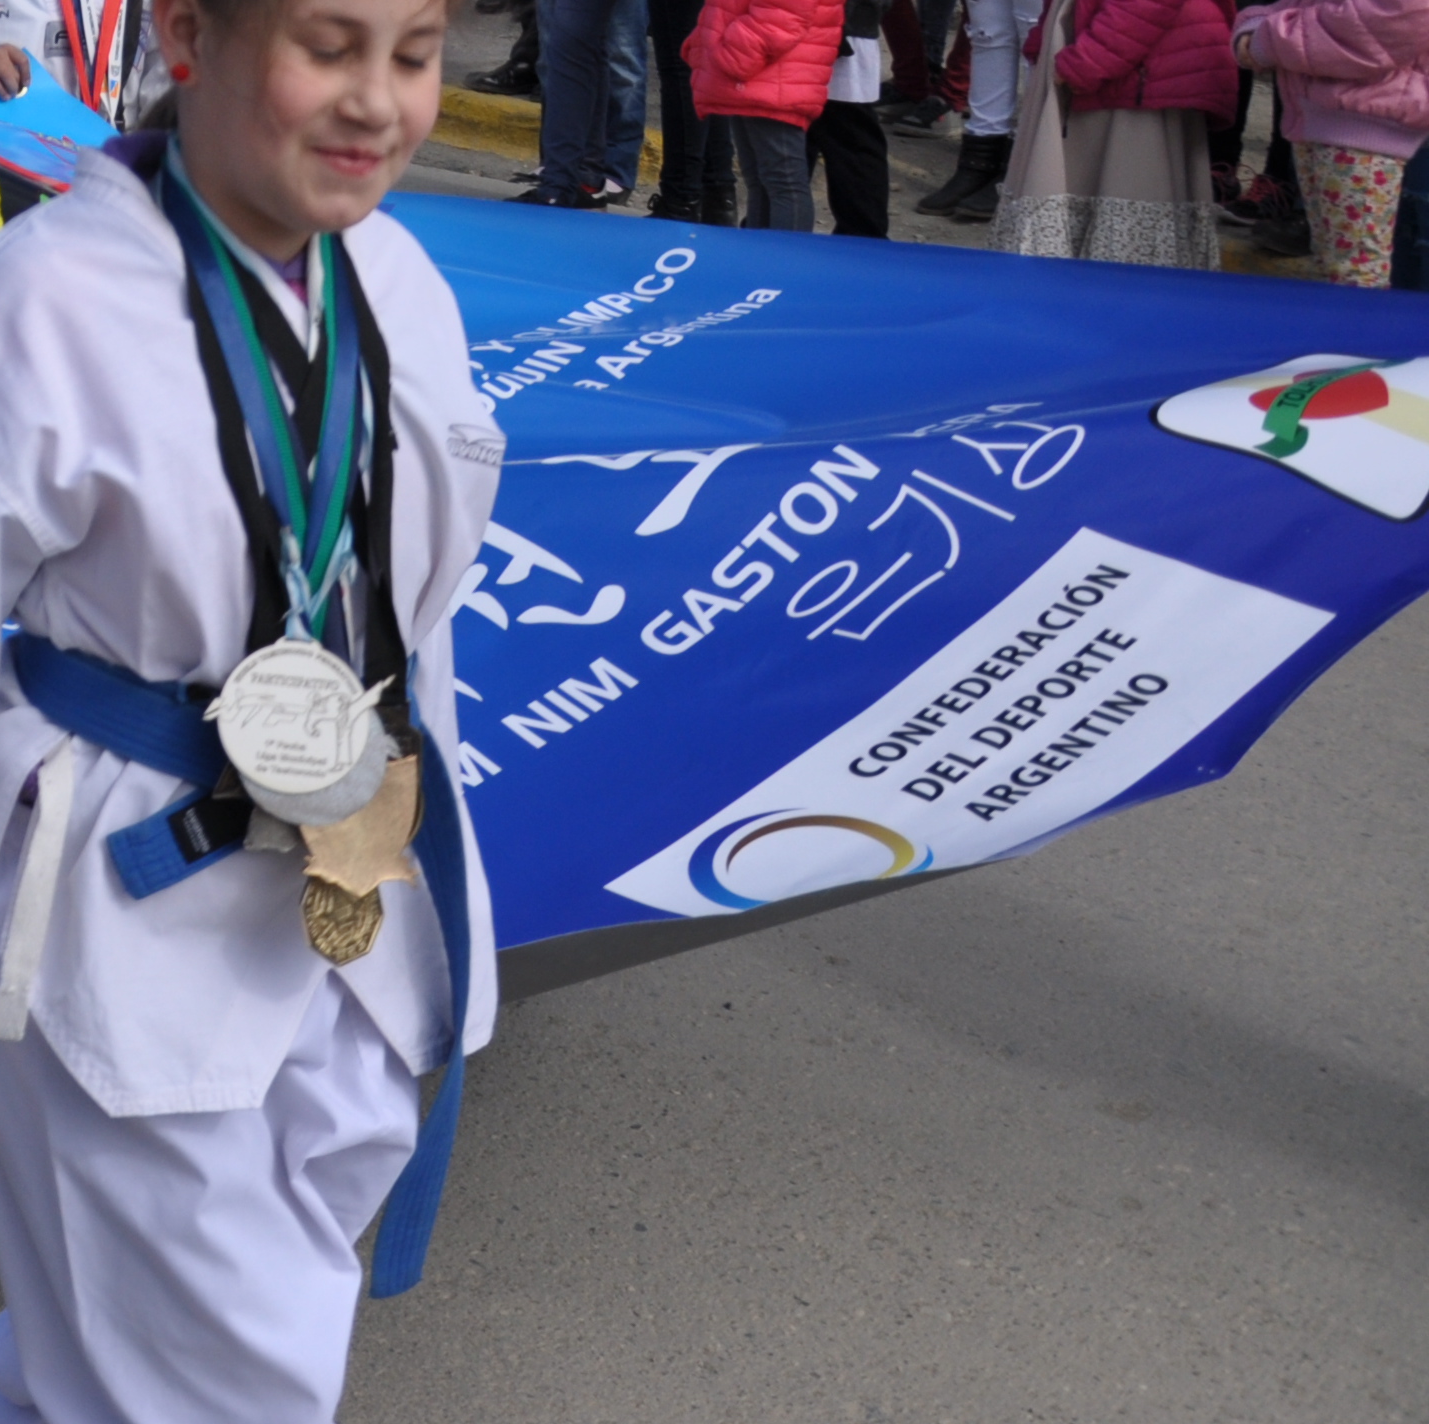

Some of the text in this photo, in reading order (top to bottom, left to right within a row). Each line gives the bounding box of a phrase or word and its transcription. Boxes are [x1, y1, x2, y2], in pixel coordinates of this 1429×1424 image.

[500, 657, 640, 750] NIM
[640, 444, 881, 656] GASTON
[848, 564, 1131, 778] CONFEDERACIÓN
[900, 628, 1138, 802] DEL DEPORTE
[964, 673, 1169, 822] ARGENTINO
